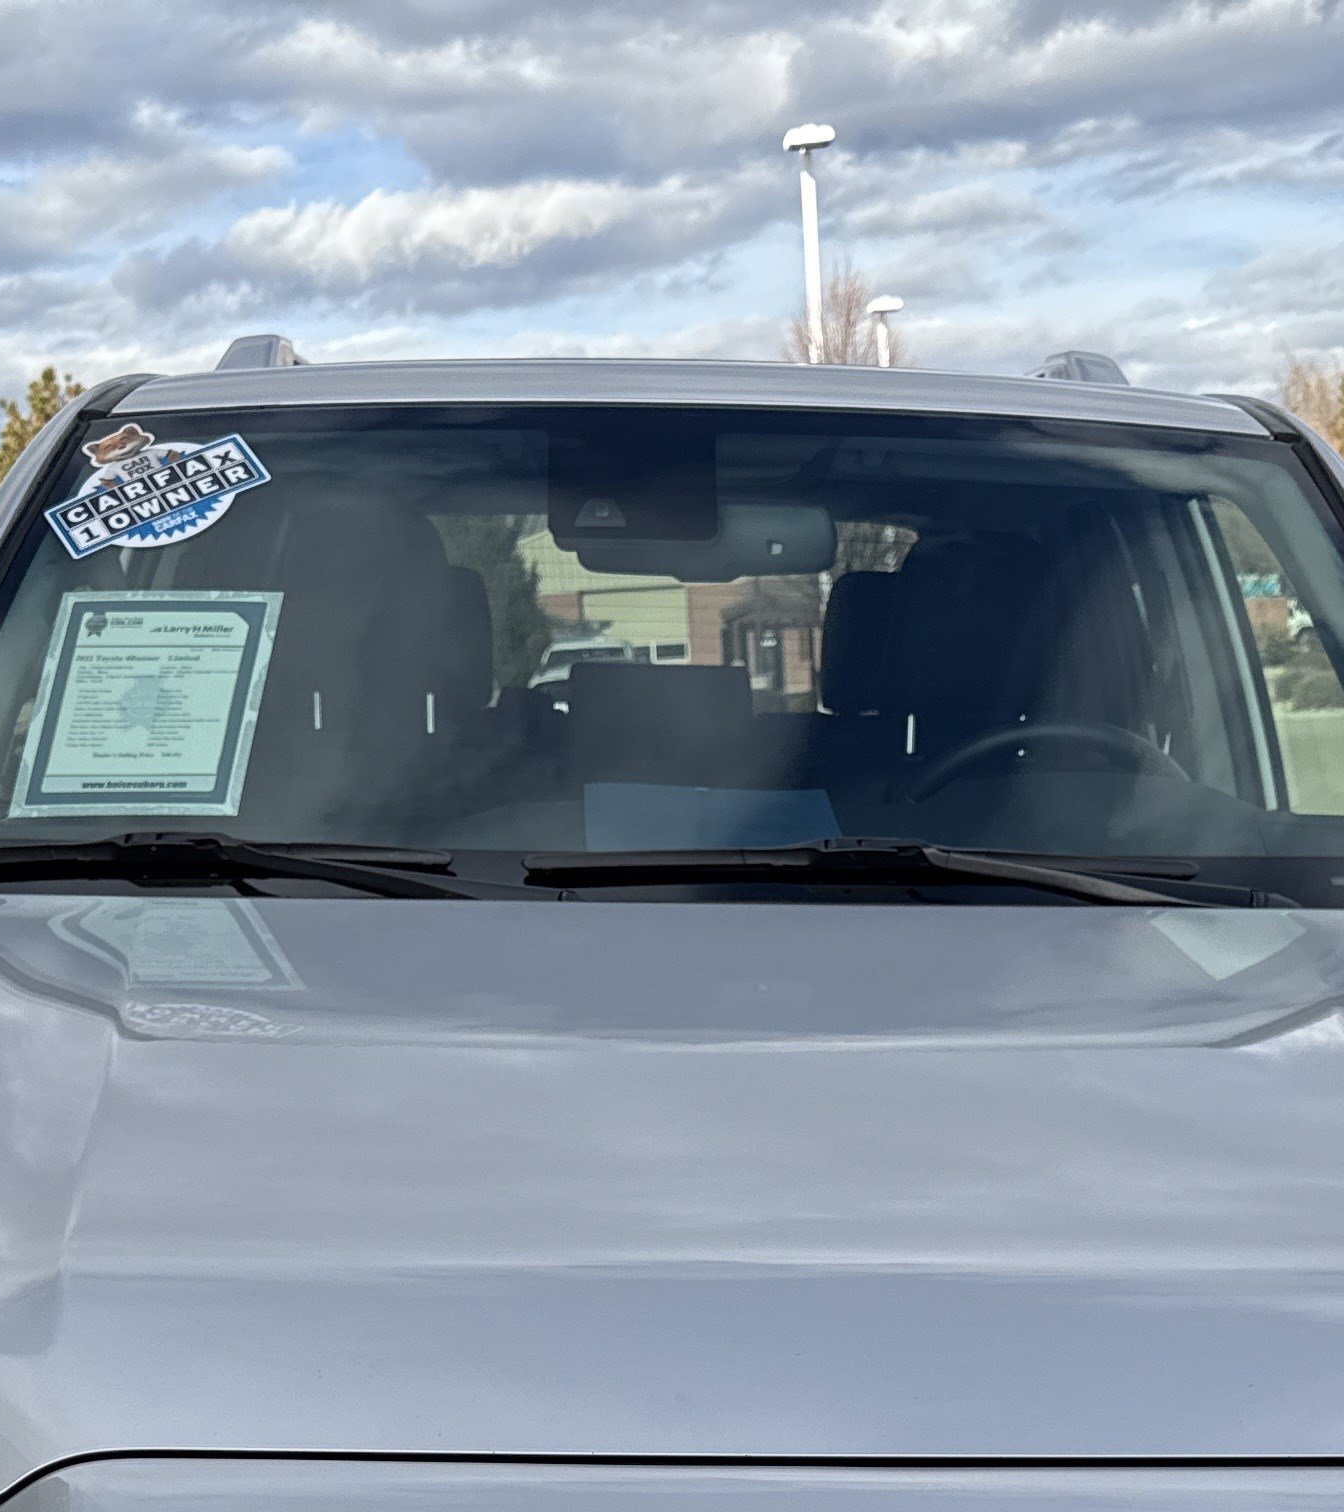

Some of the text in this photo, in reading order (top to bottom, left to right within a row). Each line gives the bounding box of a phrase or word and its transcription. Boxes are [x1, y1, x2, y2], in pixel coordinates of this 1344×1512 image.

[121, 455, 151, 471] CAR
[128, 462, 155, 479] FOX
[66, 450, 238, 523] CARFAX
[78, 527, 101, 544] 1
[107, 465, 250, 530] OWNER
